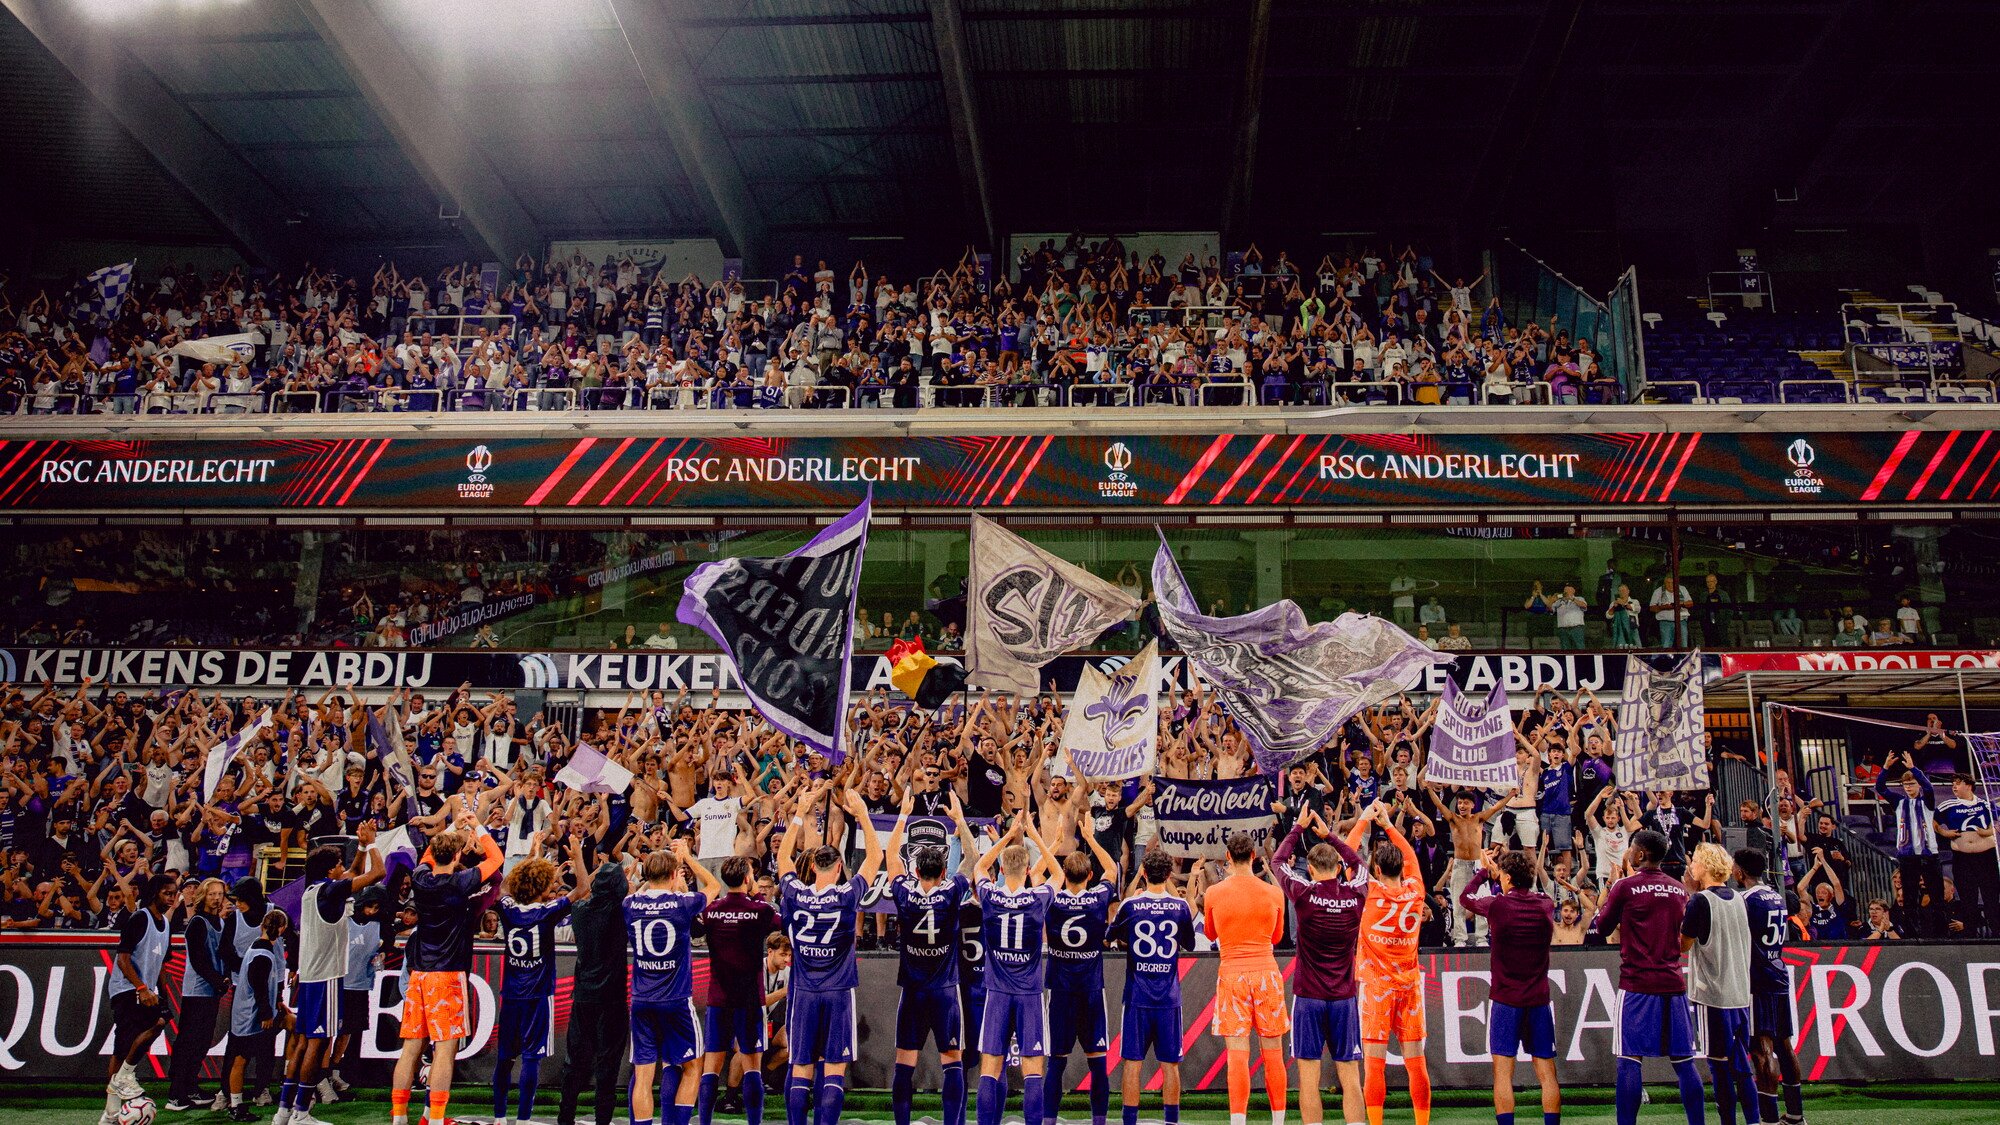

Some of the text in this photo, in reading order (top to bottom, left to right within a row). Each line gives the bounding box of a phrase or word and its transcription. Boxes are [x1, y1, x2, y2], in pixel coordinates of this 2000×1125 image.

[40, 460, 275, 483] RSC ANDERLECHT
[666, 457, 920, 482] RSC ANDERLECHT
[1320, 453, 1580, 479] RSC ANDERLECHT
[457, 483, 494, 491] EUROPA
[1098, 482, 1138, 490] EUROPA
[26, 651, 433, 687] KEUKENS DE ABDIJ
[567, 654, 745, 690] KEUKEN
[1464, 655, 1605, 691] ABDIJ
[1443, 709, 1502, 741] SPORTING
[1453, 745, 1487, 762] CLUB
[1427, 757, 1517, 783] ANDERLECHT
[1155, 784, 1276, 816] Anderlecht
[704, 812, 732, 821] Sunweb
[1160, 826, 1205, 850] Coupe
[797, 894, 839, 905] NAPOLEON
[907, 895, 946, 906] NAPOLEON
[990, 895, 1035, 907] NAPOLEON
[1054, 896, 1098, 906] NAPOLEON
[1309, 895, 1357, 908] NAPOLEON
[1631, 884, 1685, 896] NAPOLEON
[631, 901, 678, 911] NAPOLEON
[707, 911, 758, 920] NAPOLEON
[1133, 903, 1181, 911] NAPOLEON
[1371, 899, 1420, 933] 26
[630, 919, 676, 957] 10
[793, 911, 841, 944] 27
[912, 909, 940, 945] 4
[997, 913, 1025, 949] 11
[1060, 914, 1088, 948] 6
[1762, 910, 1788, 946] 55
[508, 925, 540, 958] 61
[1132, 920, 1178, 959] 83
[637, 959, 676, 971] WINKLER
[1136, 962, 1172, 973] DEGREEF
